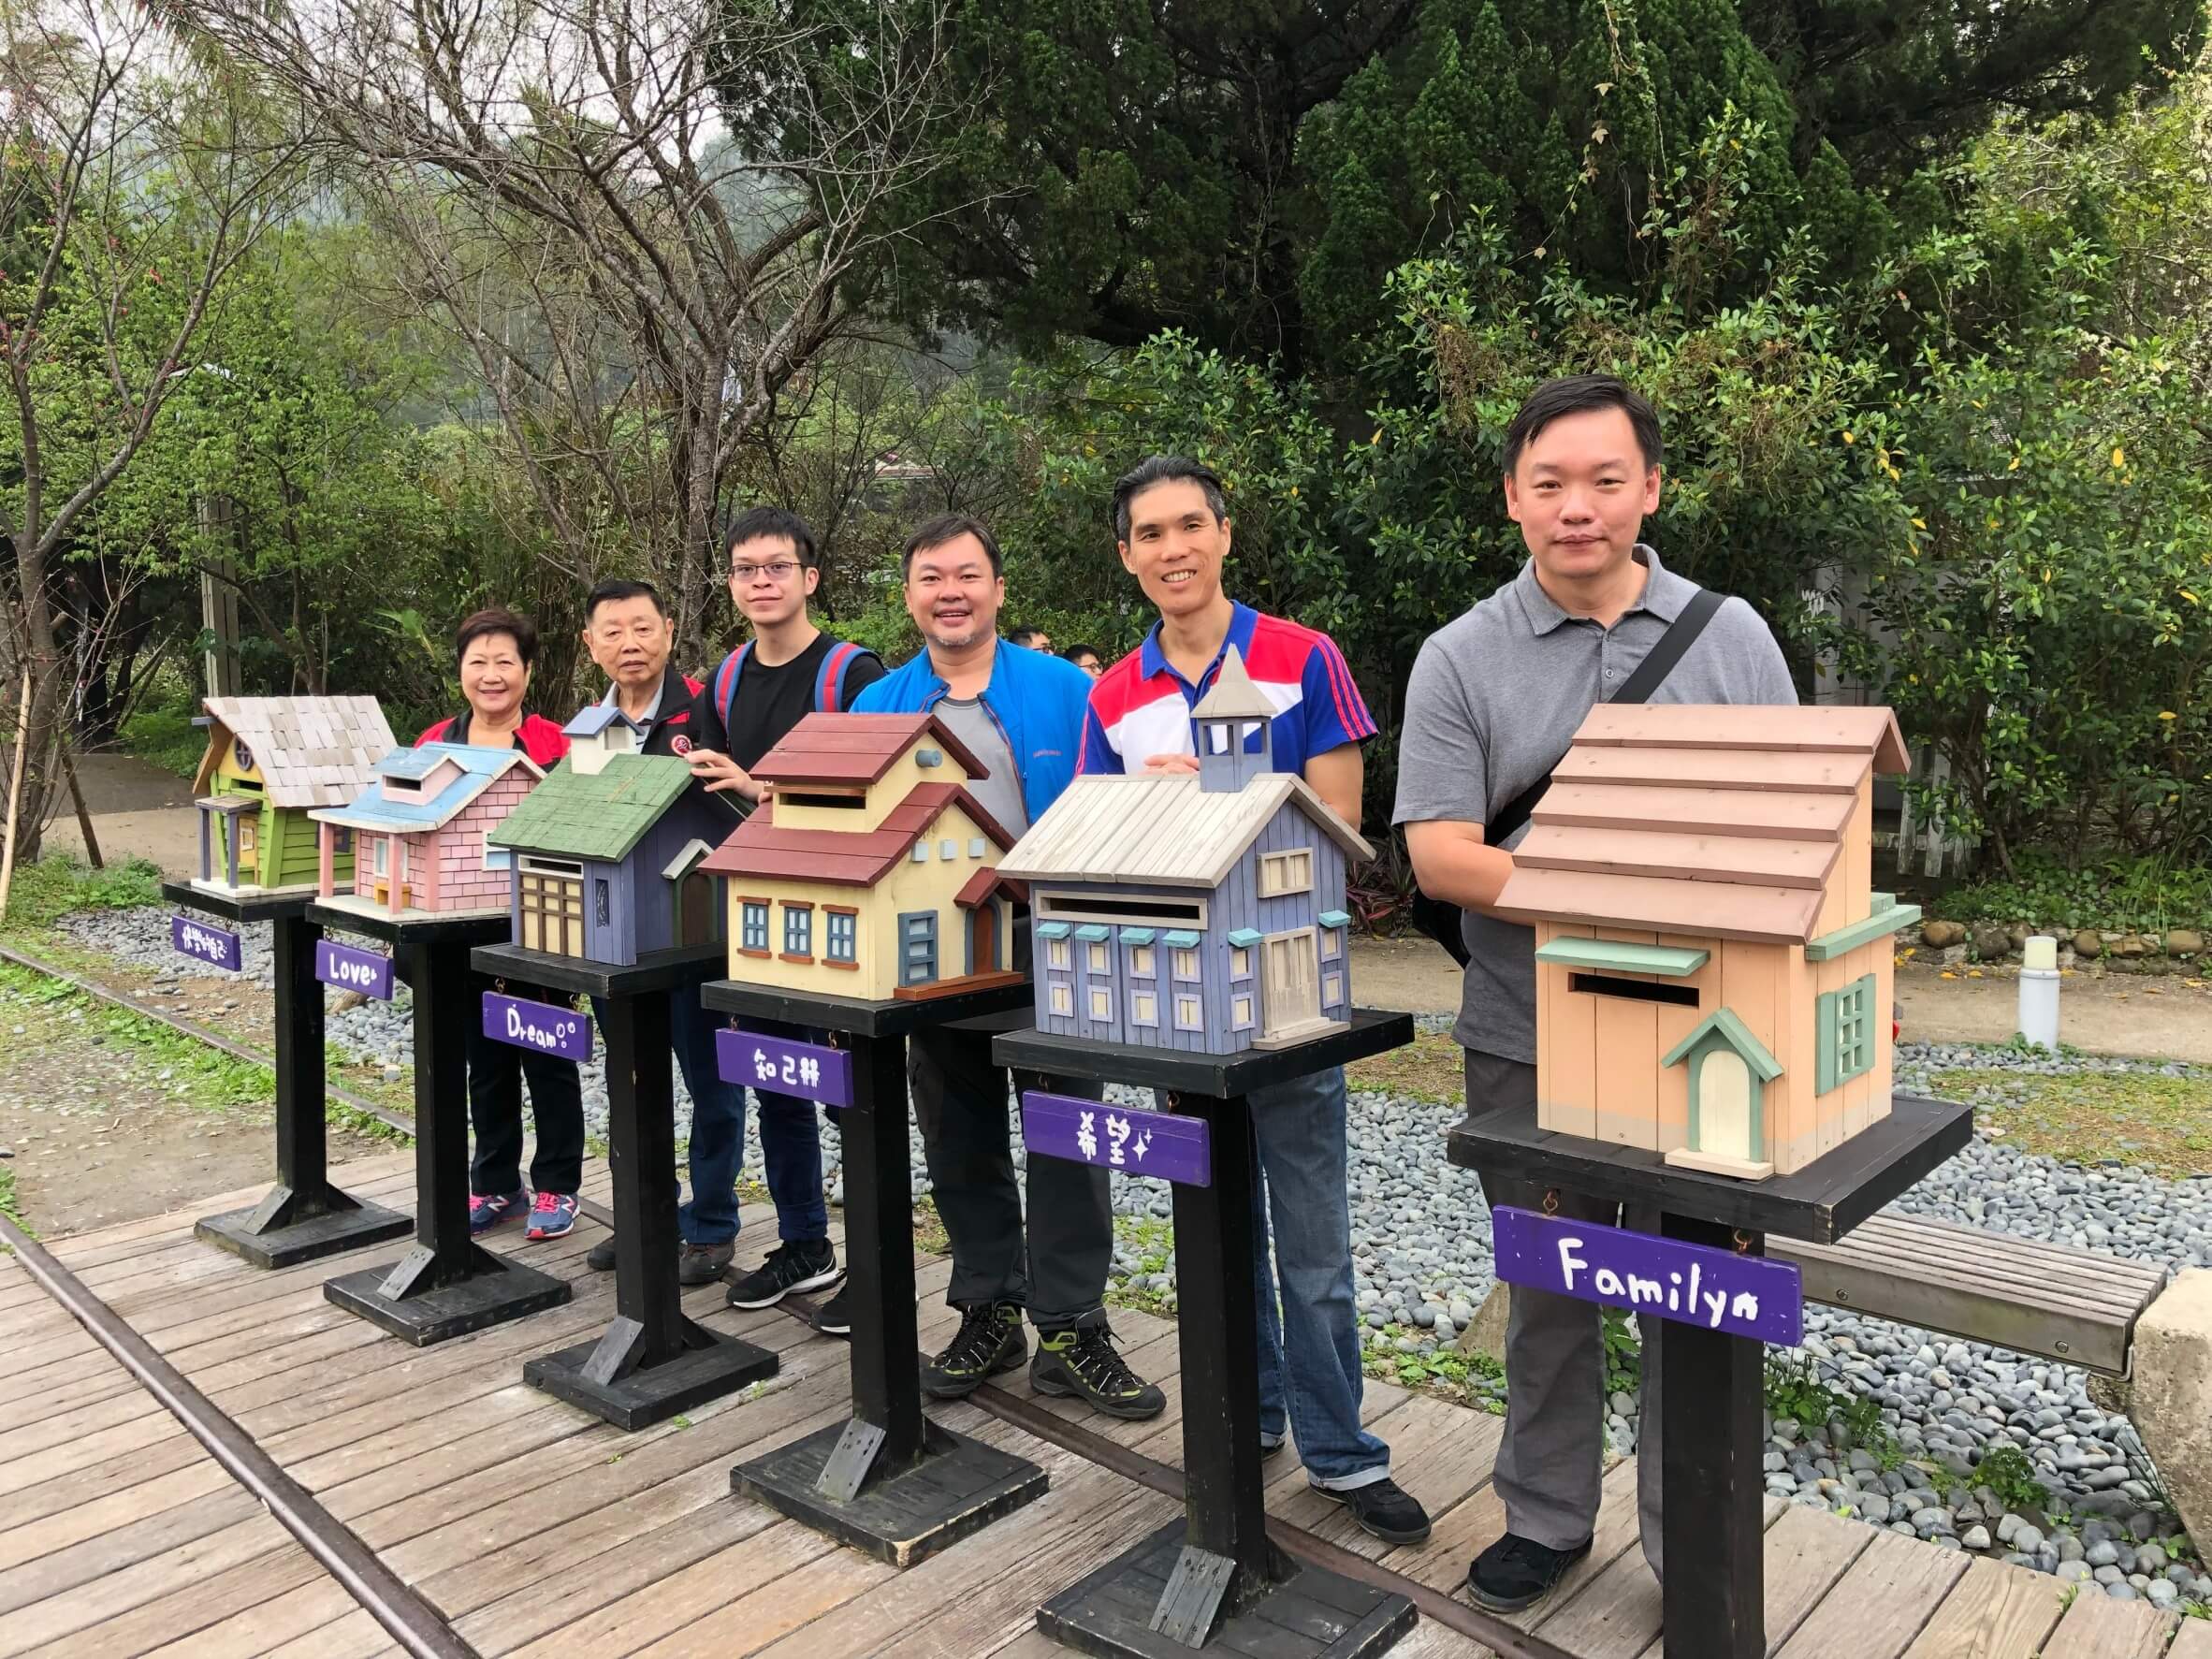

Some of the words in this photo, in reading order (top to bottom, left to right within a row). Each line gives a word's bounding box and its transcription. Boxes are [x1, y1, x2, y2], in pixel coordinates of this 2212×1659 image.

[329, 953, 371, 986] Love
[506, 1006, 557, 1049] Dream
[1077, 1111, 1131, 1165] 希望
[1557, 1237, 1727, 1329] Family
